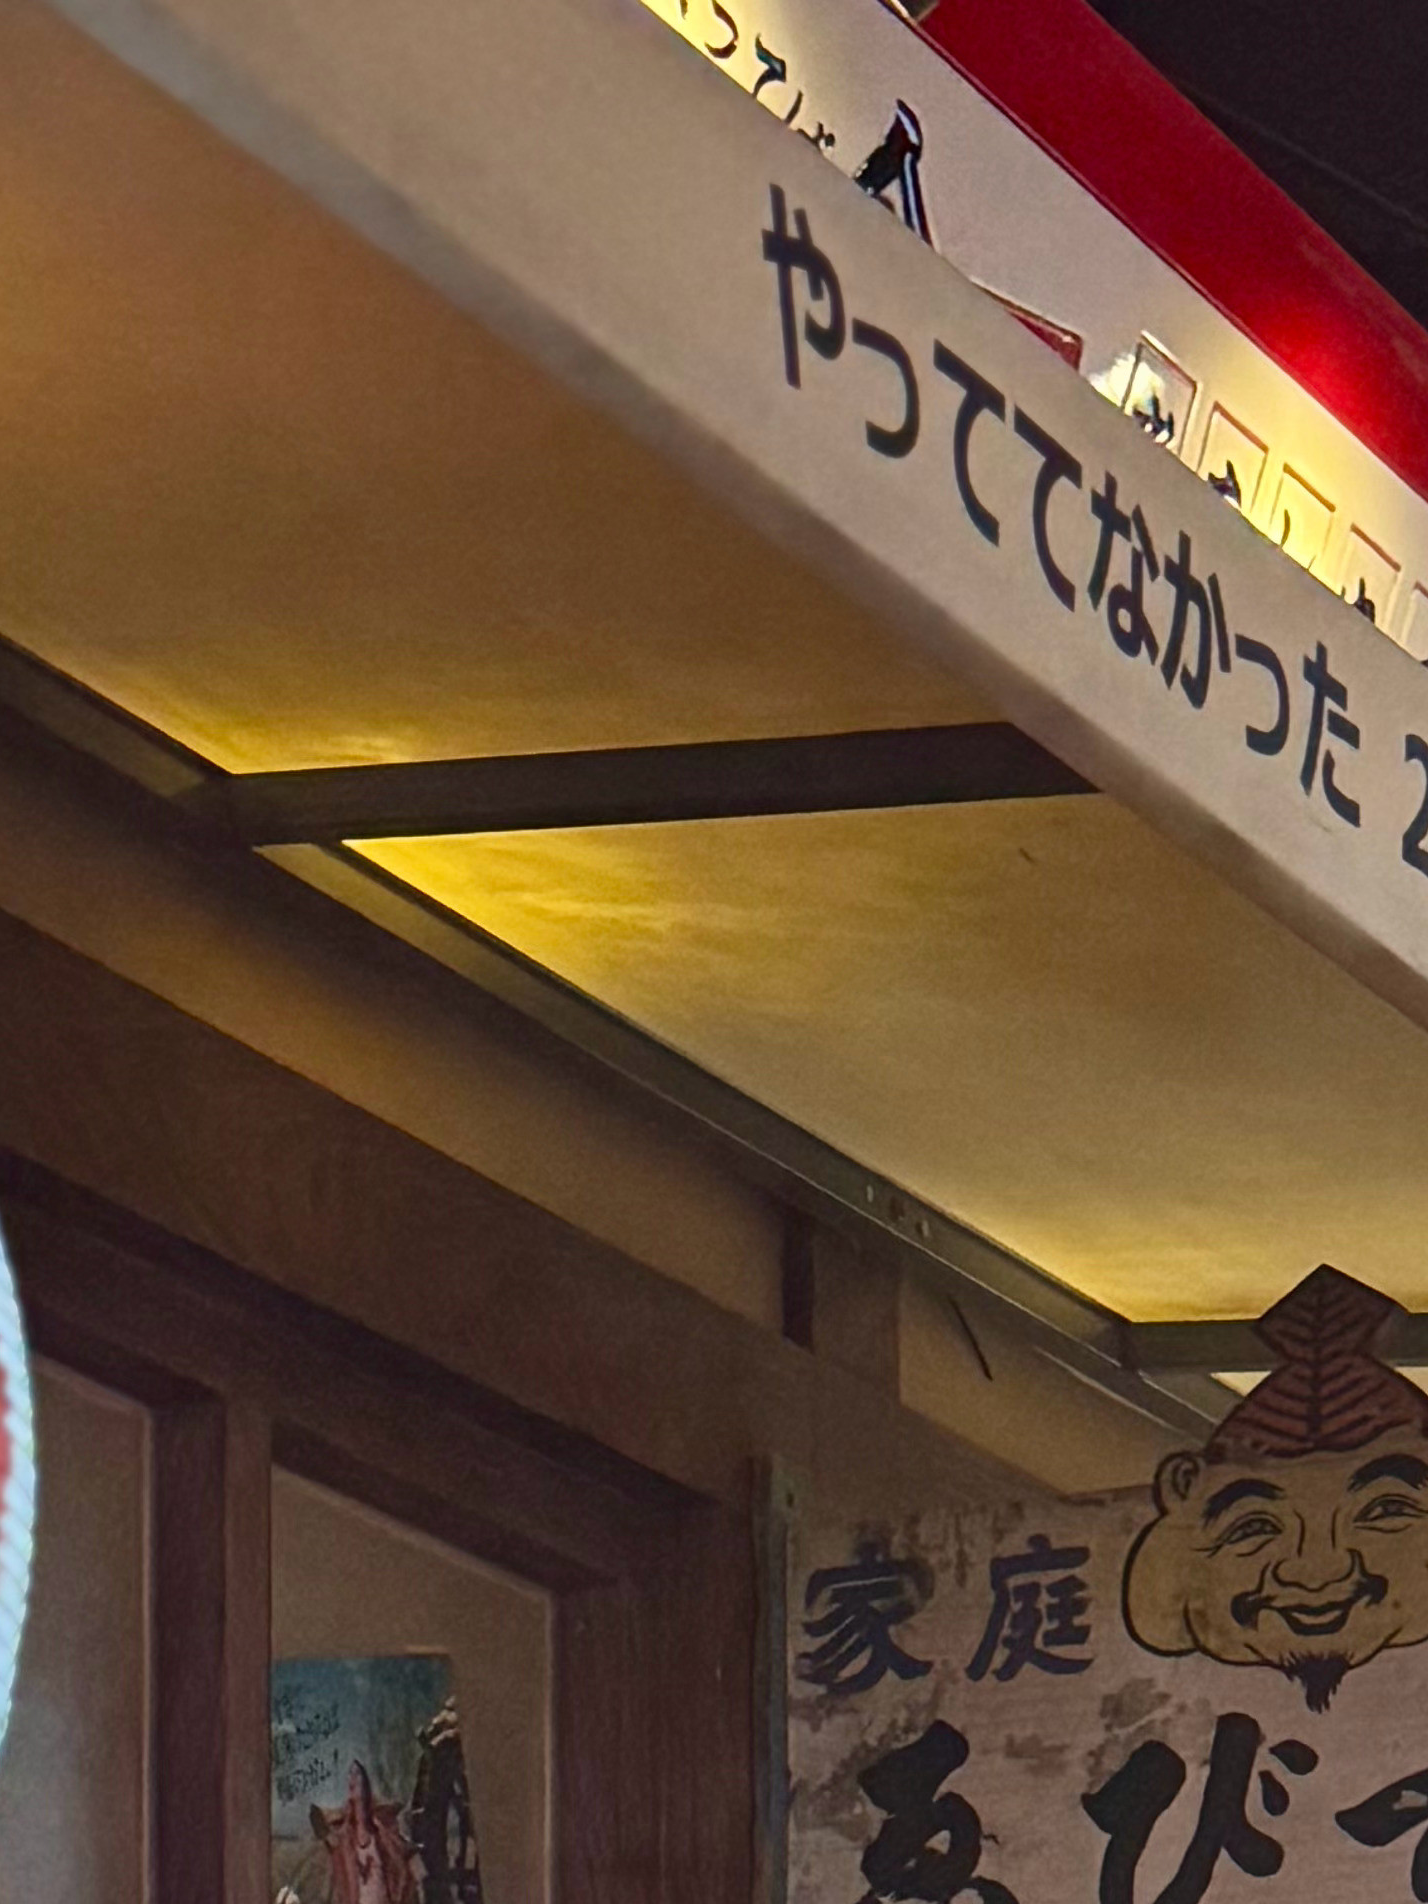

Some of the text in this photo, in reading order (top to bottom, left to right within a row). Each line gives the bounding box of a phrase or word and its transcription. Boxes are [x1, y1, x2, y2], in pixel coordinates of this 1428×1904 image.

[762, 183, 1363, 829] やっててなかった
[796, 1532, 1096, 1696] 家庭
